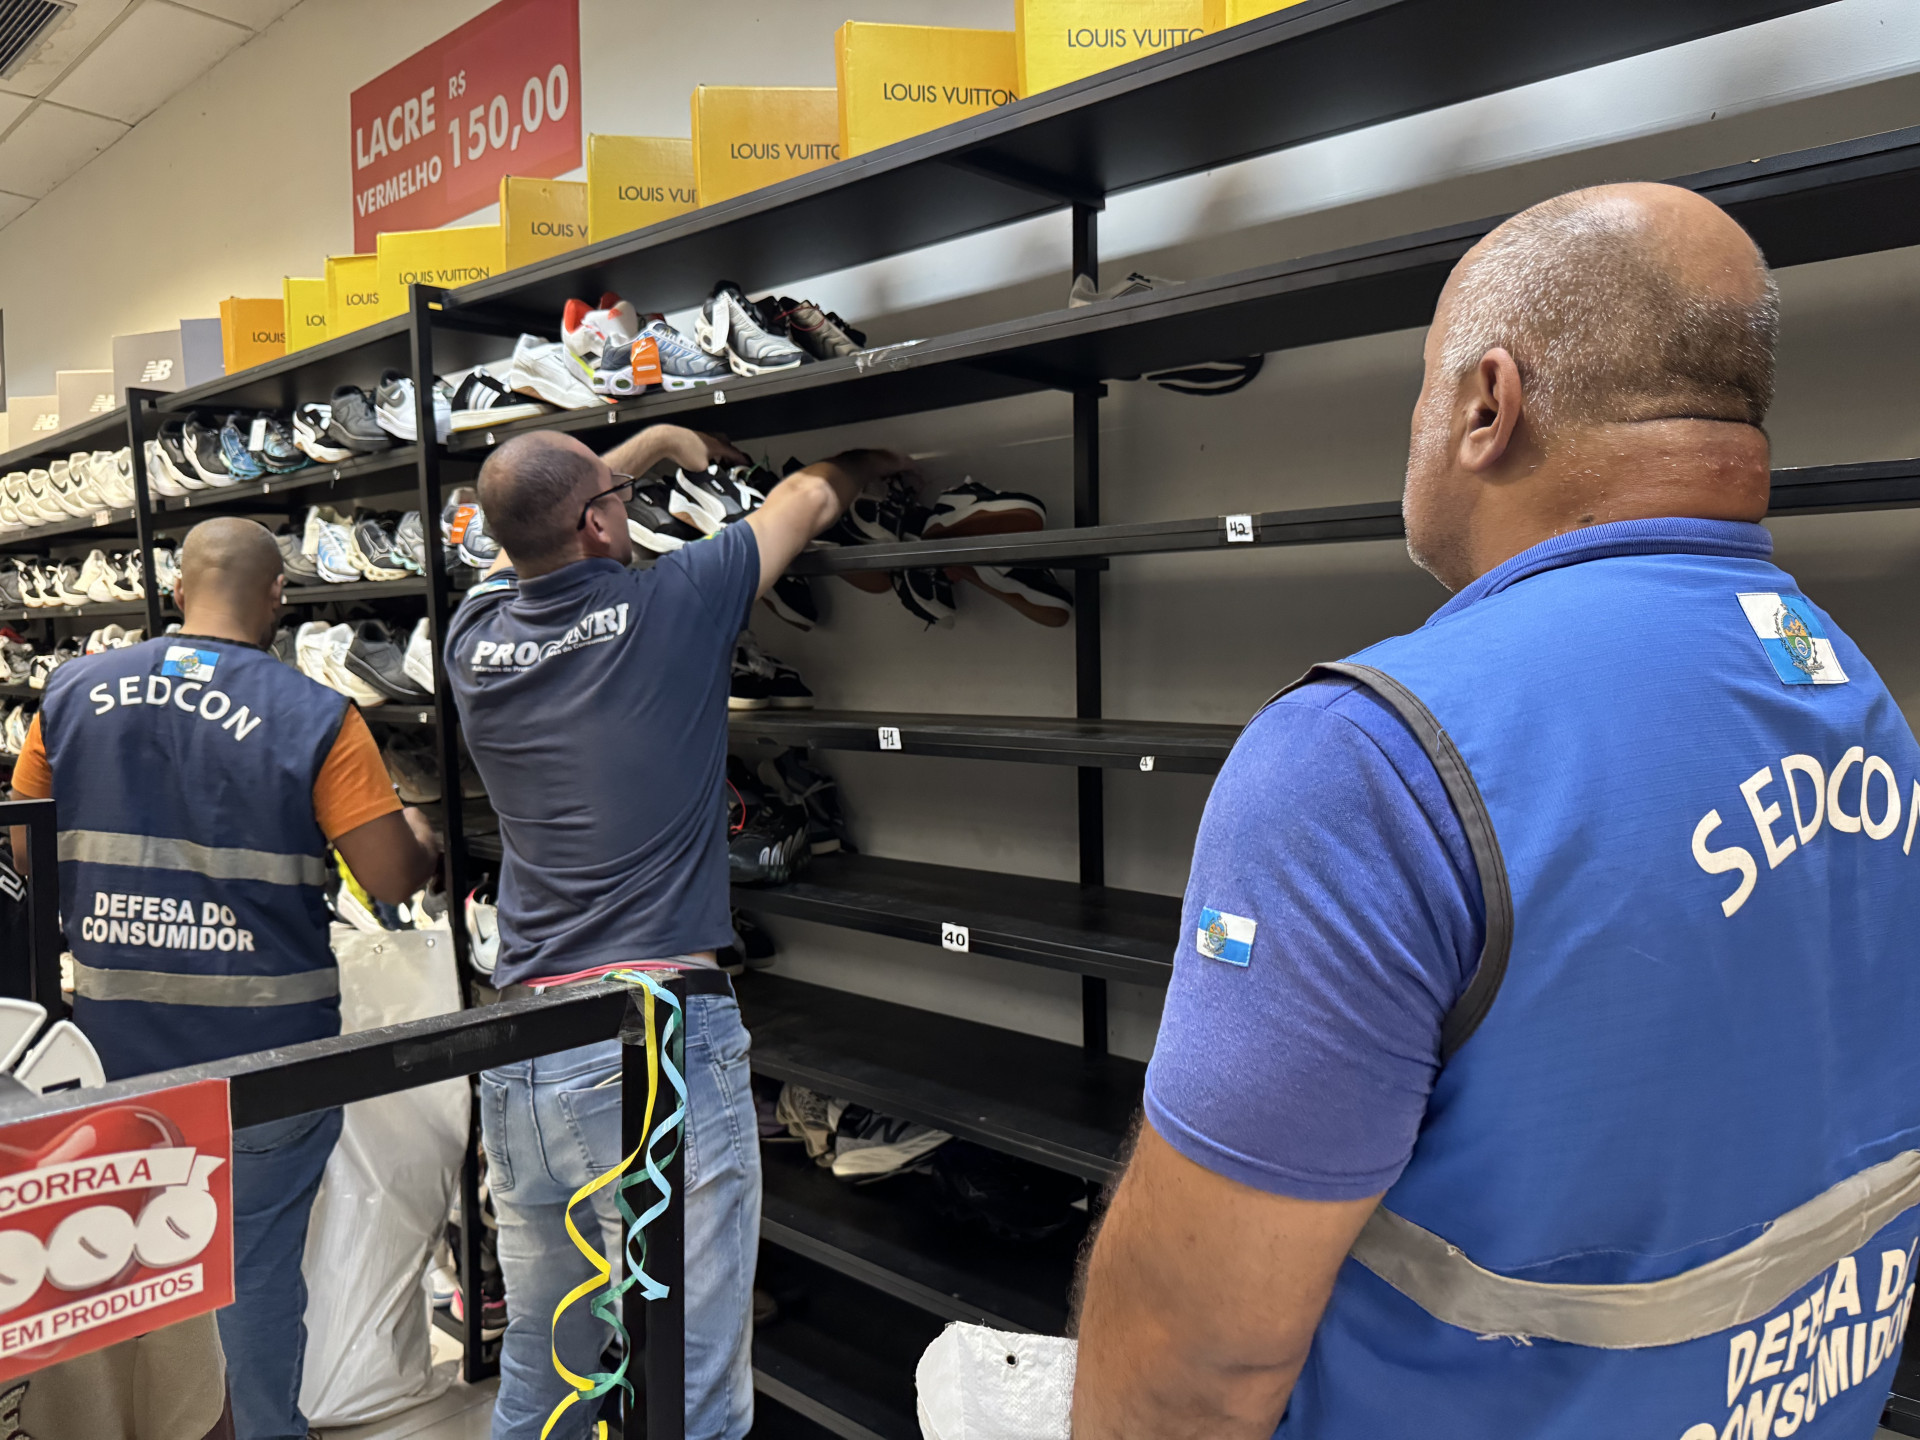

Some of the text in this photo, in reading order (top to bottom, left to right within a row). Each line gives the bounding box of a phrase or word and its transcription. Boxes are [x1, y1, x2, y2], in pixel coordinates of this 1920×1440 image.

[1067, 28, 1127, 48] LOUIS
[448, 69, 467, 100] R$
[883, 82, 937, 104] LOUIS
[447, 63, 570, 169] 150,00
[356, 86, 436, 171] LACRE
[731, 143, 780, 160] LOUIS
[356, 155, 442, 218] VERMELHO
[618, 185, 665, 202] LOUIS
[531, 221, 574, 238] LOUIS
[399, 266, 490, 285] LOUIS VUITTON
[347, 292, 380, 306] LOUIS
[1229, 521, 1250, 537] 42
[89, 674, 262, 742] SEDCON
[882, 729, 896, 748] 41
[94, 891, 237, 927] DEFESA DO
[81, 916, 255, 952] CONSUMIDOR
[944, 931, 966, 947] 40
[128, 1157, 152, 1184] A
[2, 1271, 194, 1351] EM PRODUTOS
